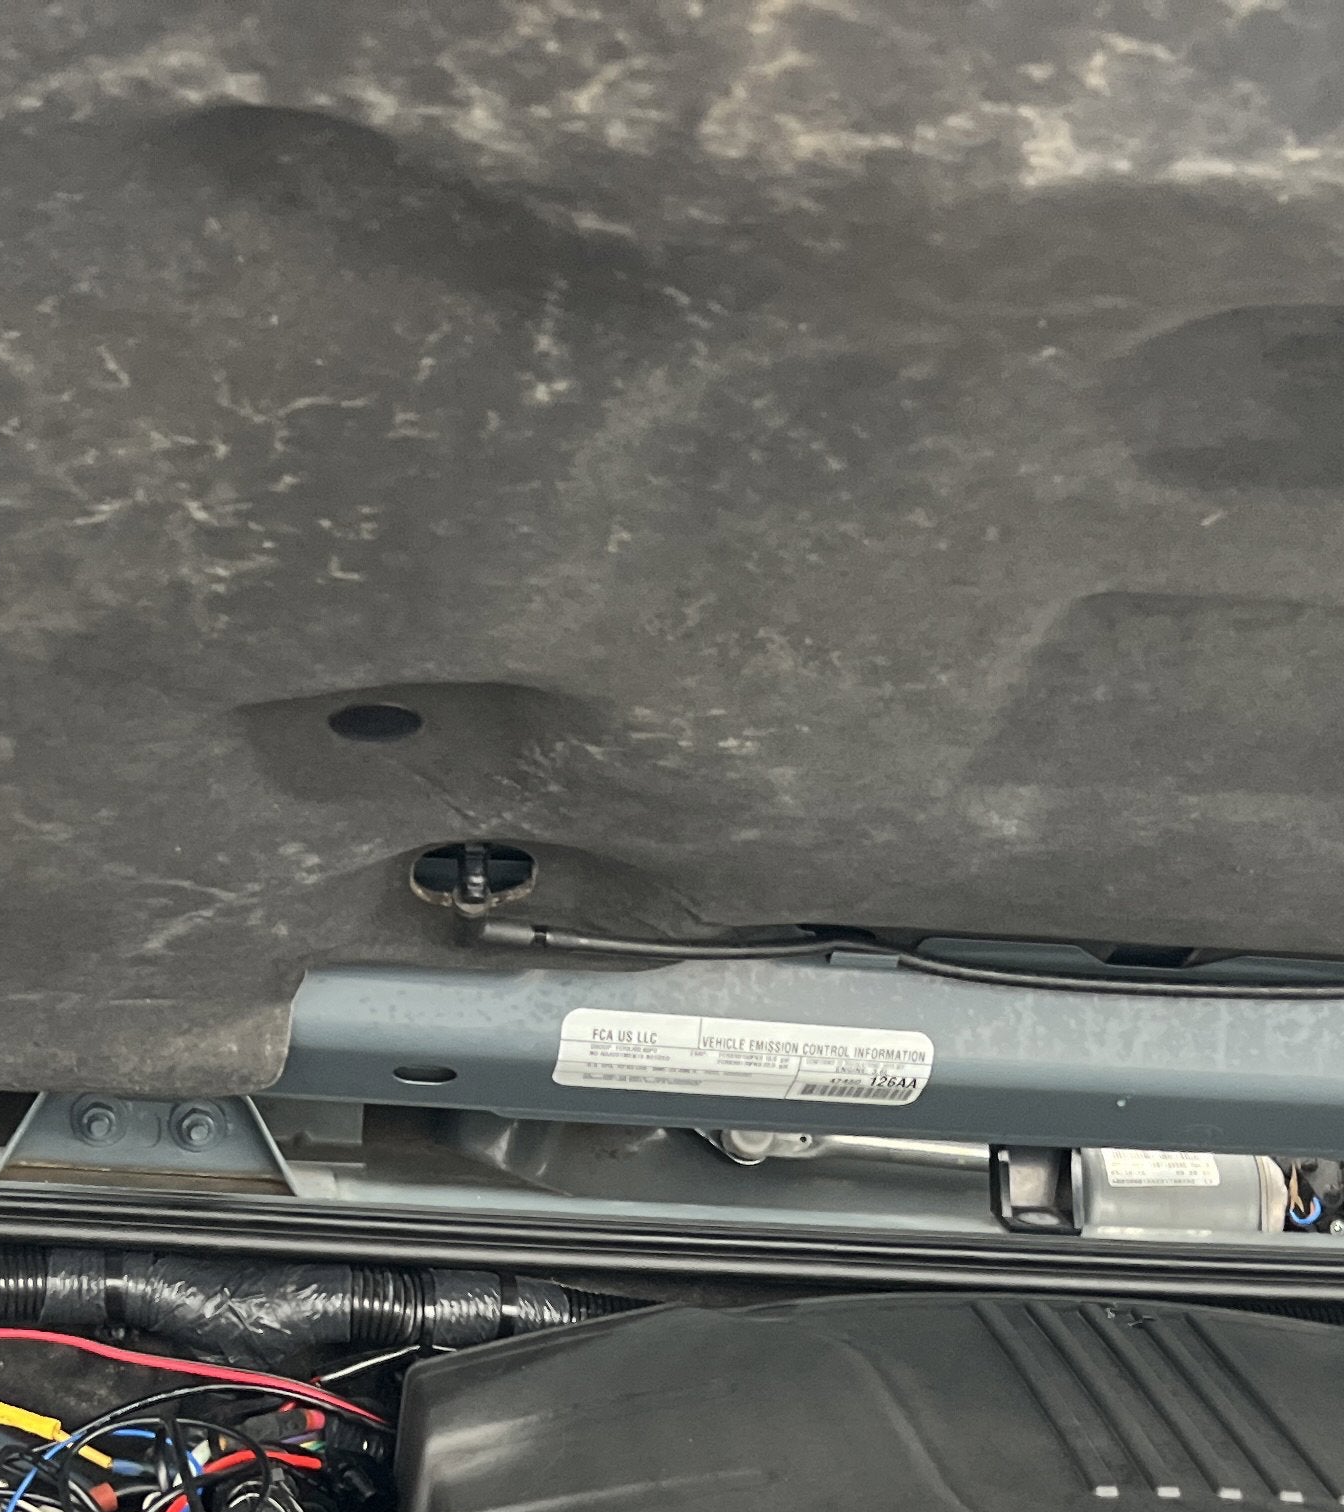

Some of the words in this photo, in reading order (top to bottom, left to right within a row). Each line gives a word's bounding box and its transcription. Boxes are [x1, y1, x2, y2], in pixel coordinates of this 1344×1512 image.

[592, 1028, 613, 1042] FCA
[618, 1030, 633, 1043] US
[637, 1031, 658, 1045] LLC
[702, 1036, 745, 1051] VEHICLE
[749, 1039, 798, 1054] EMISSION
[802, 1043, 850, 1058] CONTROL
[854, 1047, 926, 1062] INFORMATION
[870, 1076, 918, 1089] 126AA
